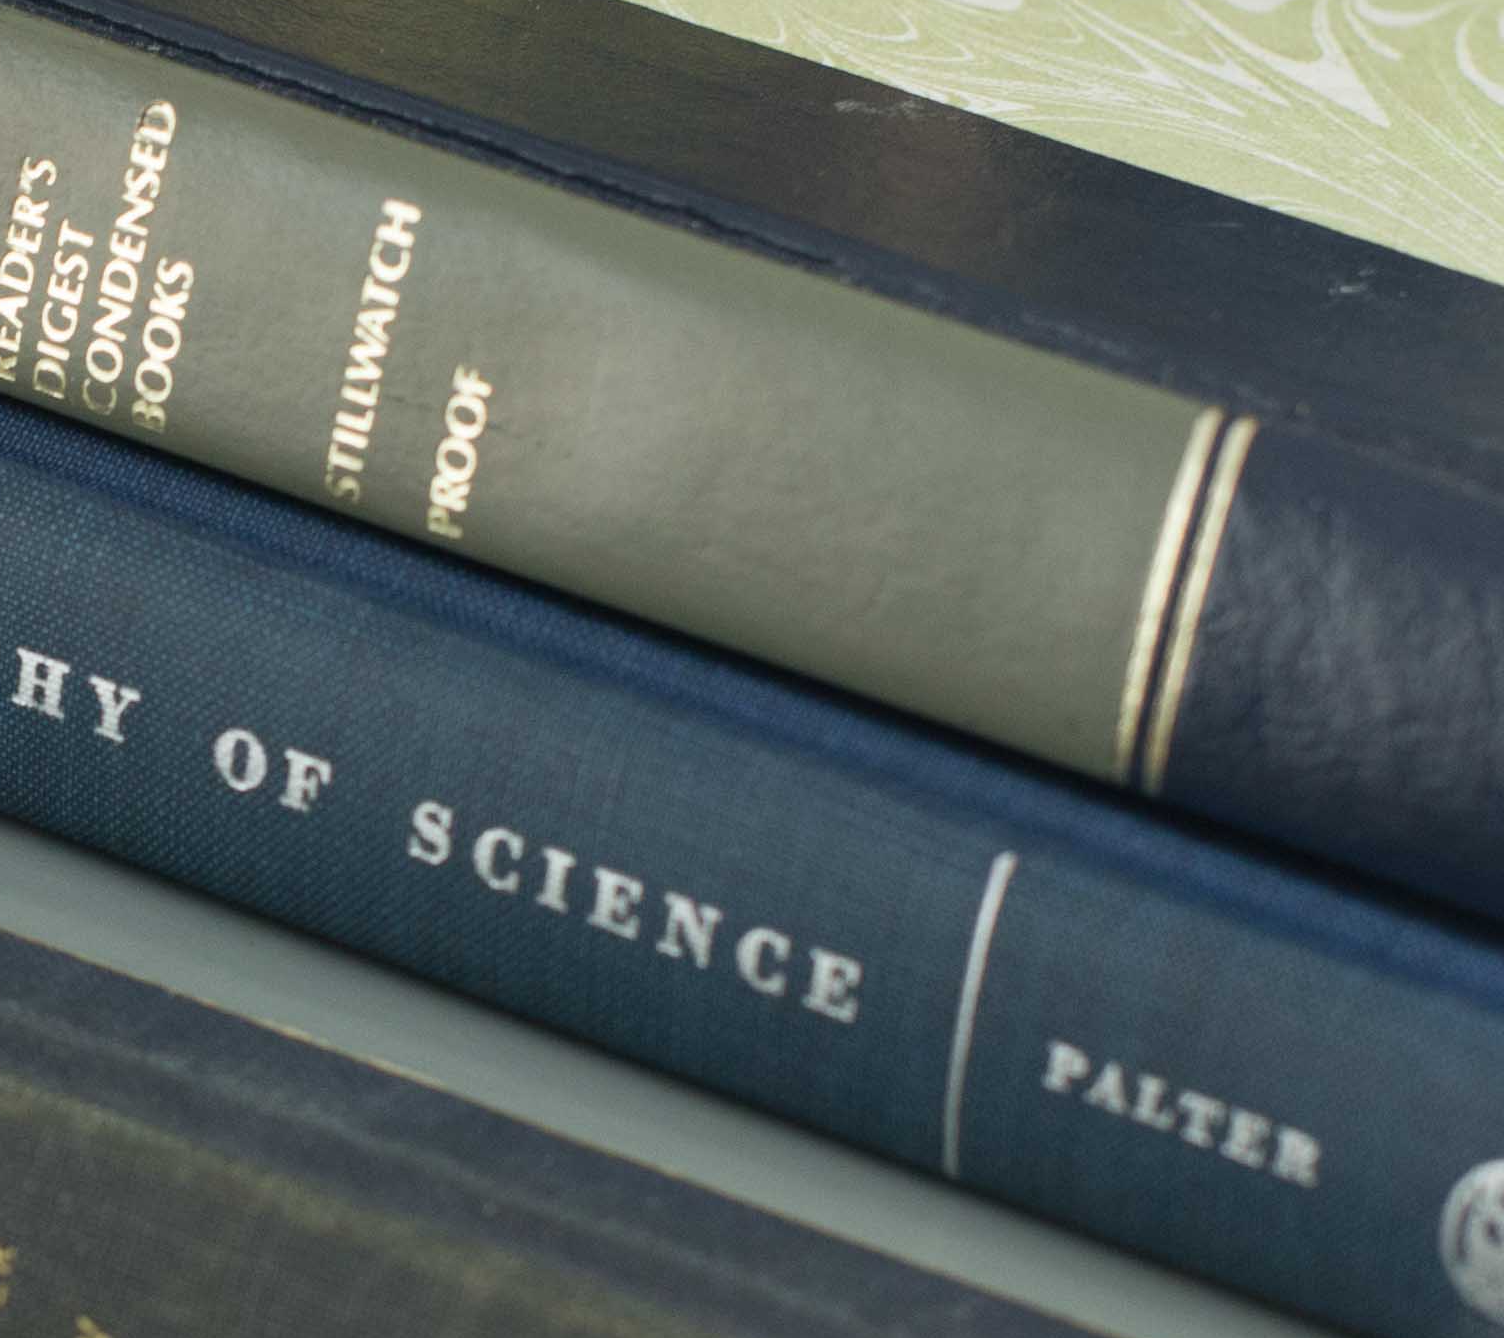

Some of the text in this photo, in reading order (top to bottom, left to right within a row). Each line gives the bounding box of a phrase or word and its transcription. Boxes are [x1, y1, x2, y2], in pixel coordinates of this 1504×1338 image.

[32, 218, 94, 400] DIGEST
[83, 99, 177, 416] CONDENSED
[131, 257, 194, 433] BOOKS
[324, 197, 423, 504] STILLWATCH
[426, 363, 493, 540] PROOF
[213, 727, 333, 813] OF
[406, 800, 865, 1025] SCIENCE
[1040, 1040, 1324, 1188] PALTER
